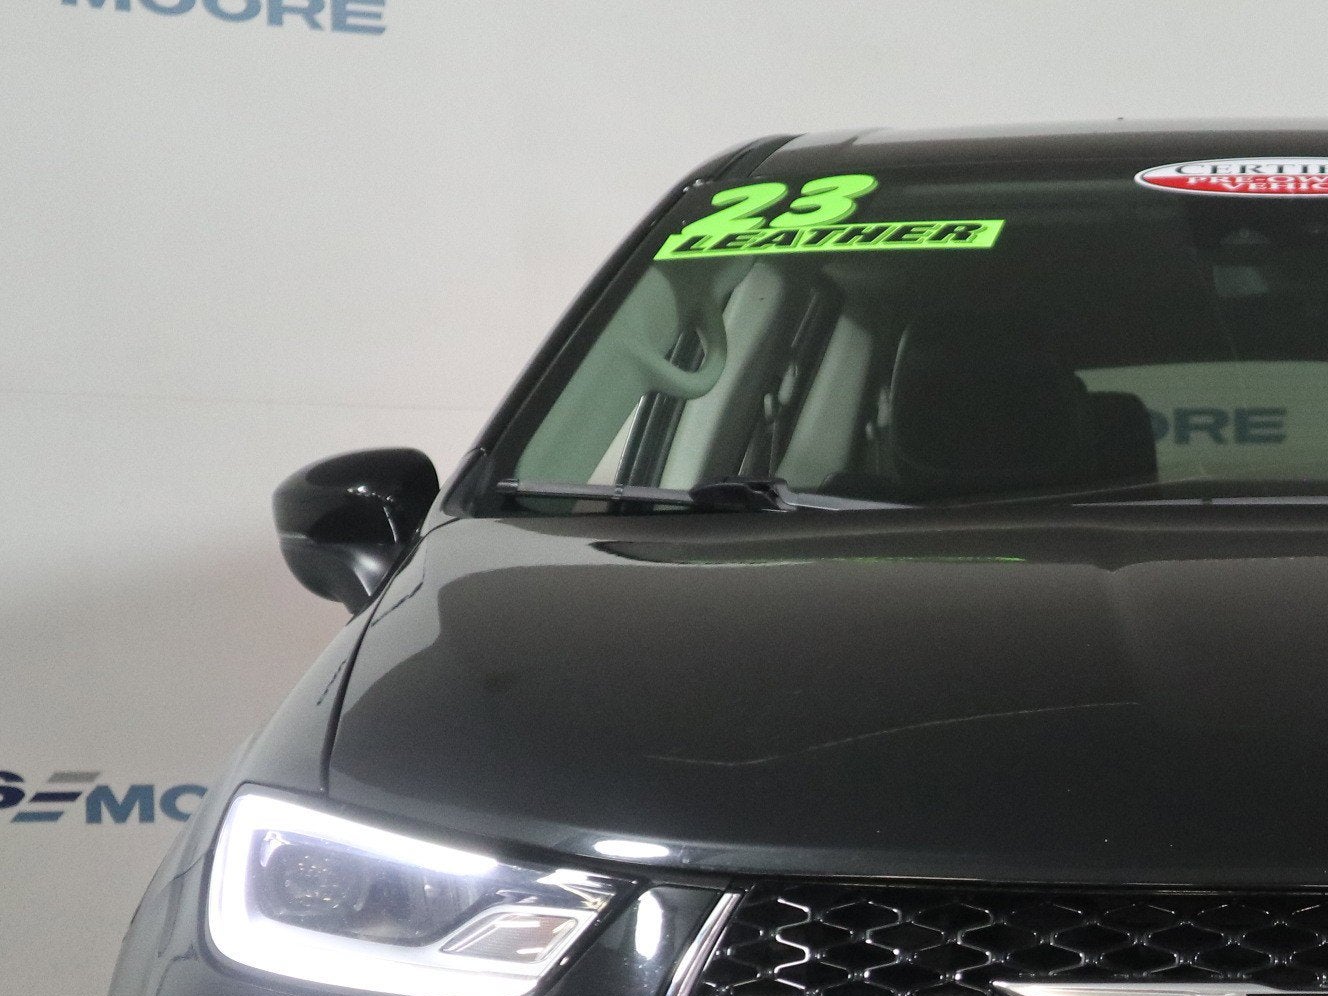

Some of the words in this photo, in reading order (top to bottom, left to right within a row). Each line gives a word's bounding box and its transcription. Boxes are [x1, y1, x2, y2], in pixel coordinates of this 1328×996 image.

[60, 0, 386, 36] ORE
[681, 174, 879, 235] 23
[670, 222, 988, 253] LEATHER
